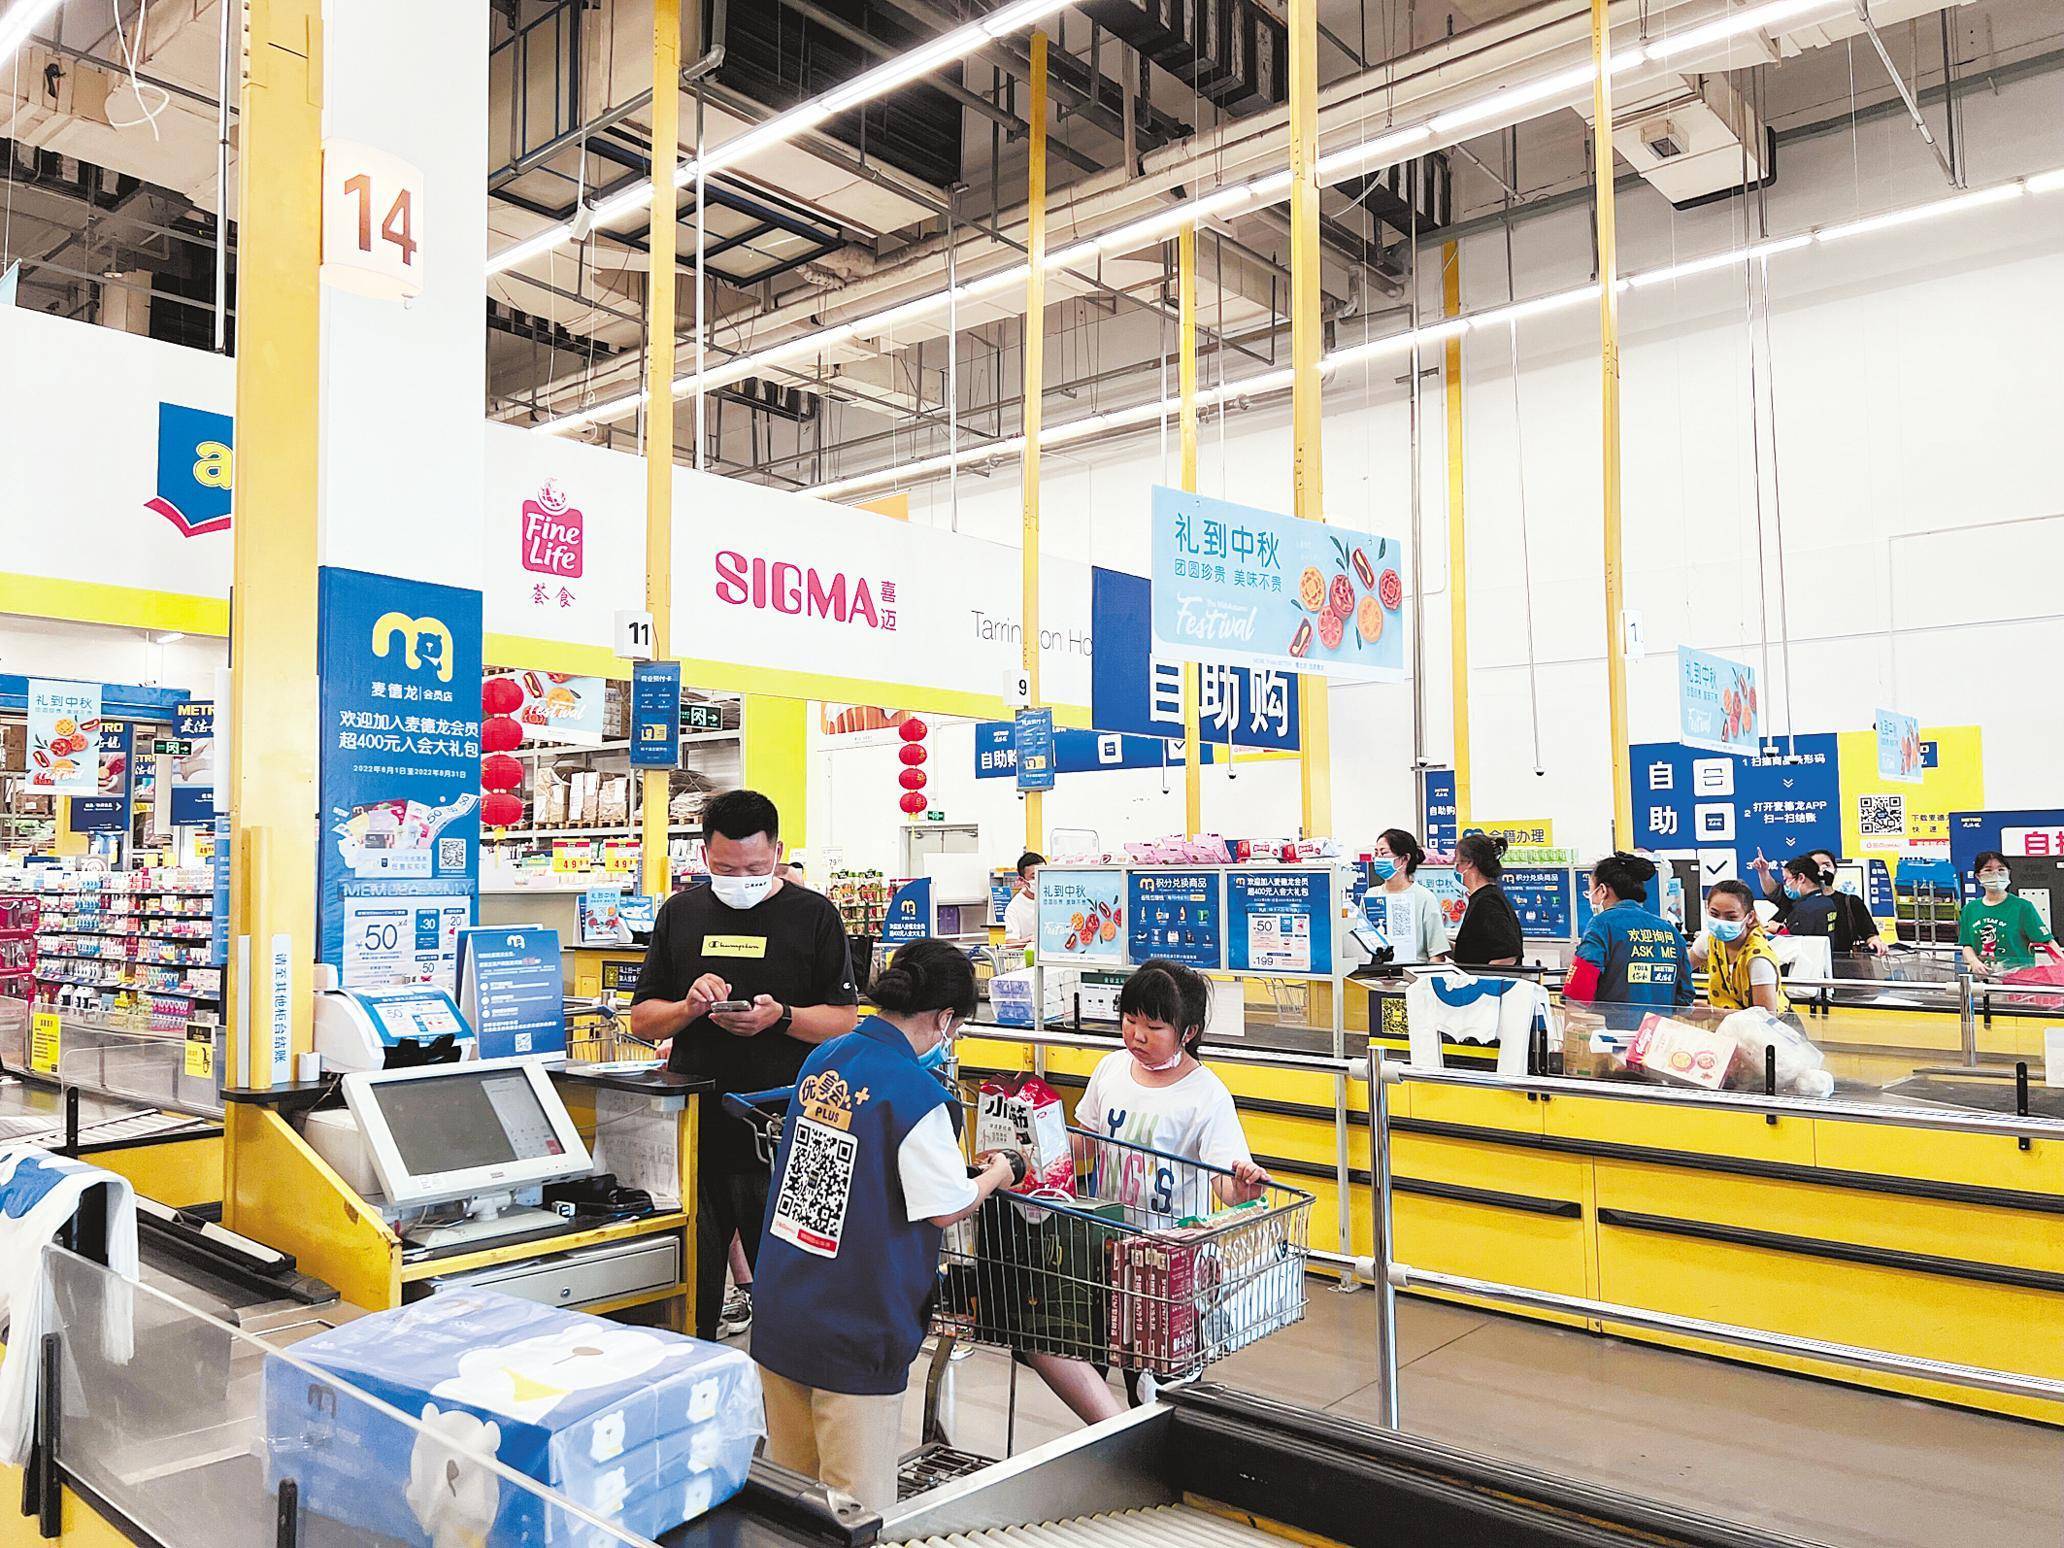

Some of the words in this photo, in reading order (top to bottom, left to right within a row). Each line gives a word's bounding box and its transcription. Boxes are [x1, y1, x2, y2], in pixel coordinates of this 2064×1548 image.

[344, 173, 418, 267] 14
[525, 510, 580, 546] Fine
[1175, 512, 1281, 570] 礼到中秋
[529, 540, 577, 572] Life
[715, 550, 879, 629] SIGMA
[1174, 558, 1226, 584] 团圆珍贵
[1233, 568, 1282, 592] 美味不贵
[880, 580, 898, 632] 喜迈
[628, 621, 650, 646] 11
[971, 610, 1062, 651] Tarrinon
[371, 681, 419, 700] 麦德龙
[1018, 679, 1027, 696] 9
[100, 722, 124, 733] TRO
[339, 710, 479, 739] 欢迎加入麦德龙会员
[338, 731, 479, 758] 超400元入会大礼包
[1911, 814, 1950, 822] 下载麦德
[1155, 878, 1207, 888] 积分兑换商品
[1631, 946, 1654, 958] ASK
[1660, 946, 1678, 959] ME
[800, 1072, 846, 1107] 优享会
[814, 1104, 841, 1123] PLUS
